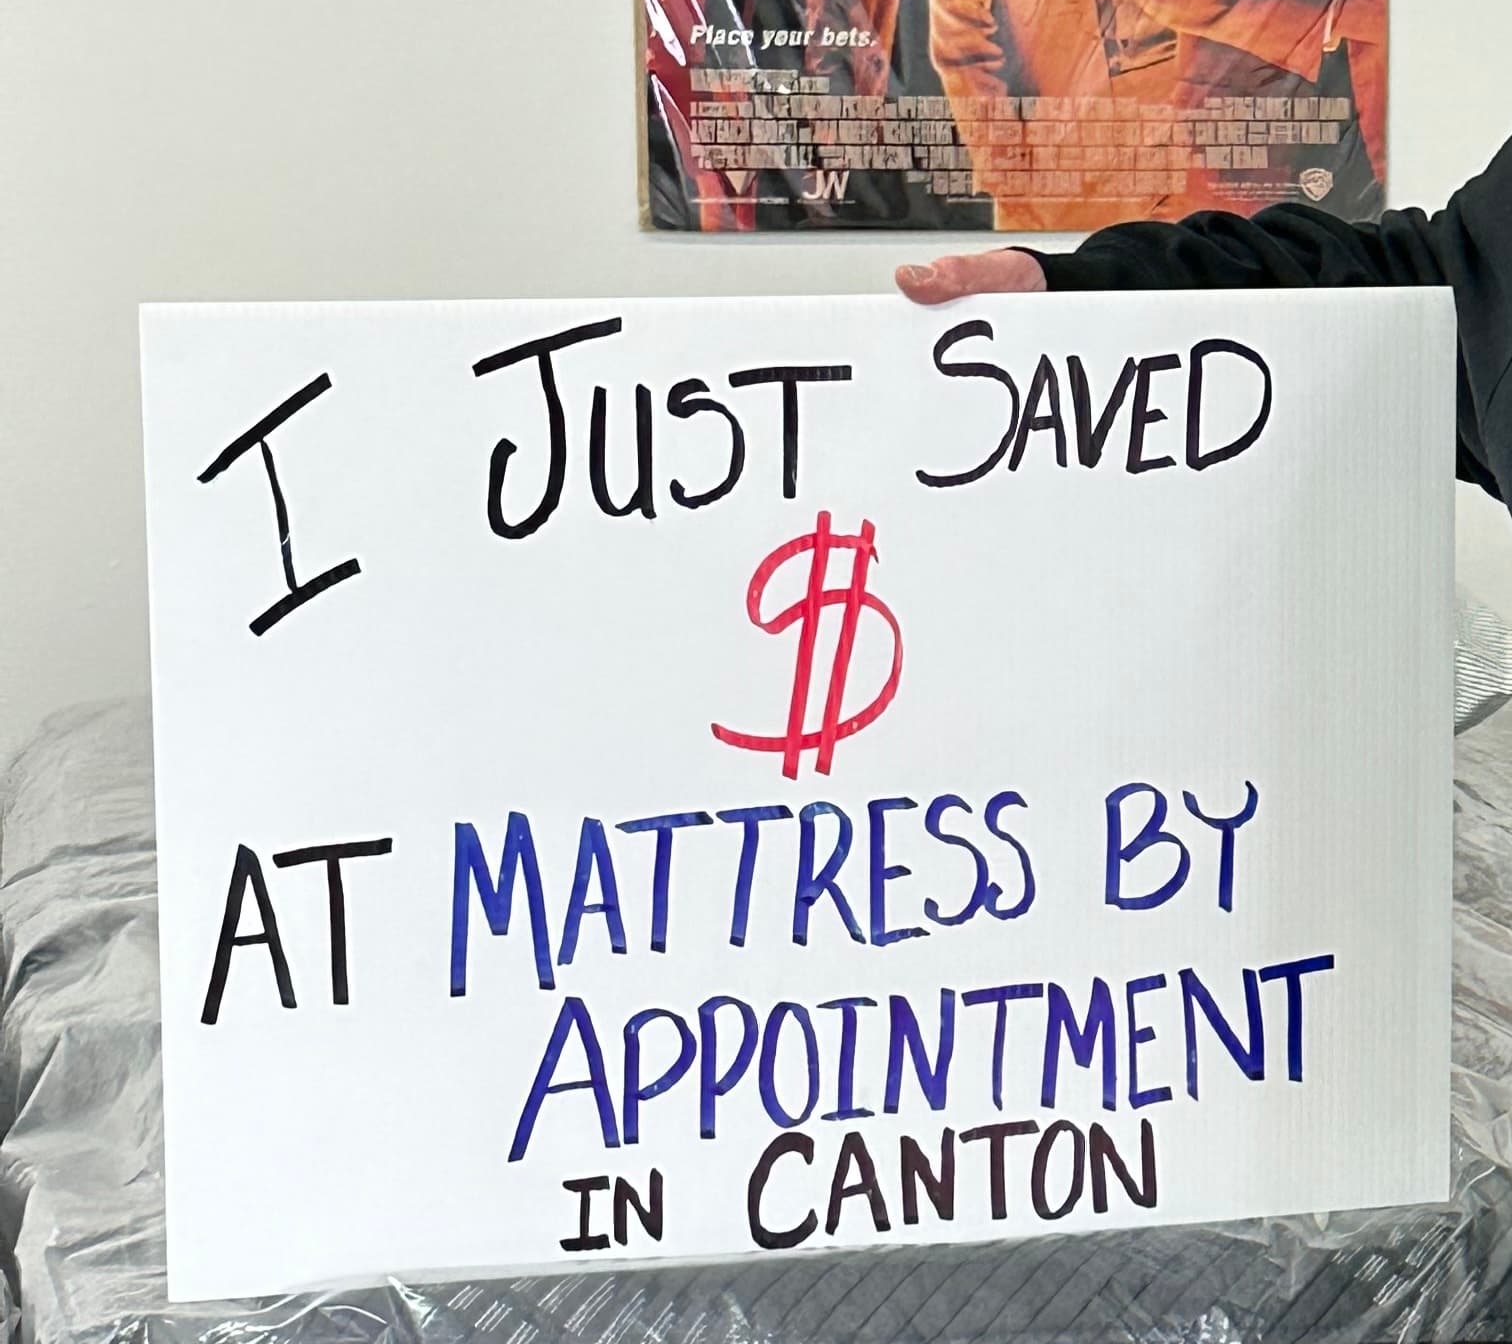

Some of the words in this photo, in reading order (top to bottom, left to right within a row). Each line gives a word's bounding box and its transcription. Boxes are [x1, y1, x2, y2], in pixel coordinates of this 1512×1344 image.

[690, 24, 755, 48] Place
[760, 27, 814, 51] your
[819, 25, 878, 48] bets.
[197, 371, 362, 637] I
[472, 317, 852, 540] JUST
[915, 319, 1272, 488] SAVED
[711, 510, 904, 781] $
[200, 837, 393, 1025] AT
[450, 791, 1036, 996] MATTRESS
[1105, 780, 1259, 913] BY
[508, 954, 1334, 1162] APPOINTMENT
[559, 1167, 663, 1252] IN
[748, 1118, 1157, 1250] CANTON
